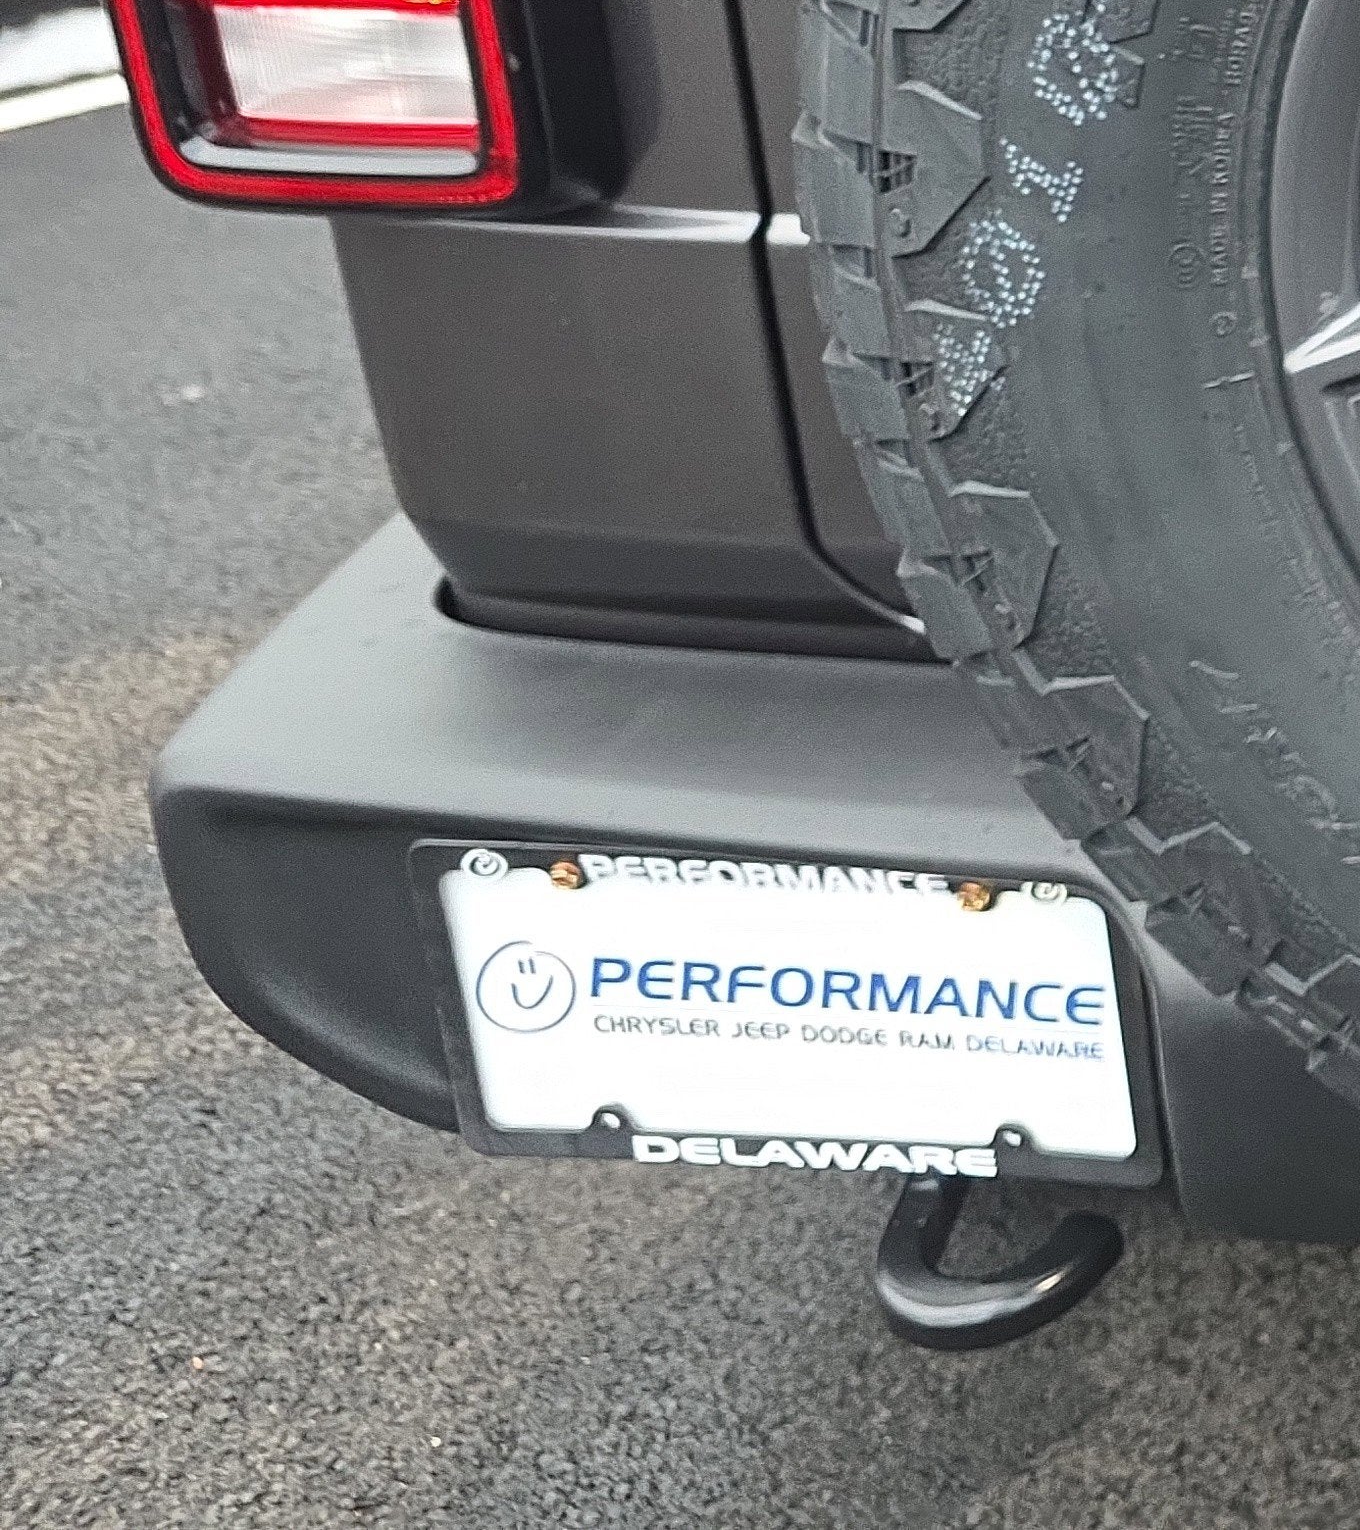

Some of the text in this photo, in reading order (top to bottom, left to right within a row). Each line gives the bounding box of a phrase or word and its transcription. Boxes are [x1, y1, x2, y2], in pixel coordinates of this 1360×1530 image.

[577, 852, 953, 896] PERFORMANCE
[590, 957, 1107, 1027] PERFORMANCE
[593, 1014, 1106, 1061] CHRYSLER JEEP DODGE RAM DELAWARE
[632, 1134, 1000, 1178] DELAWARE
